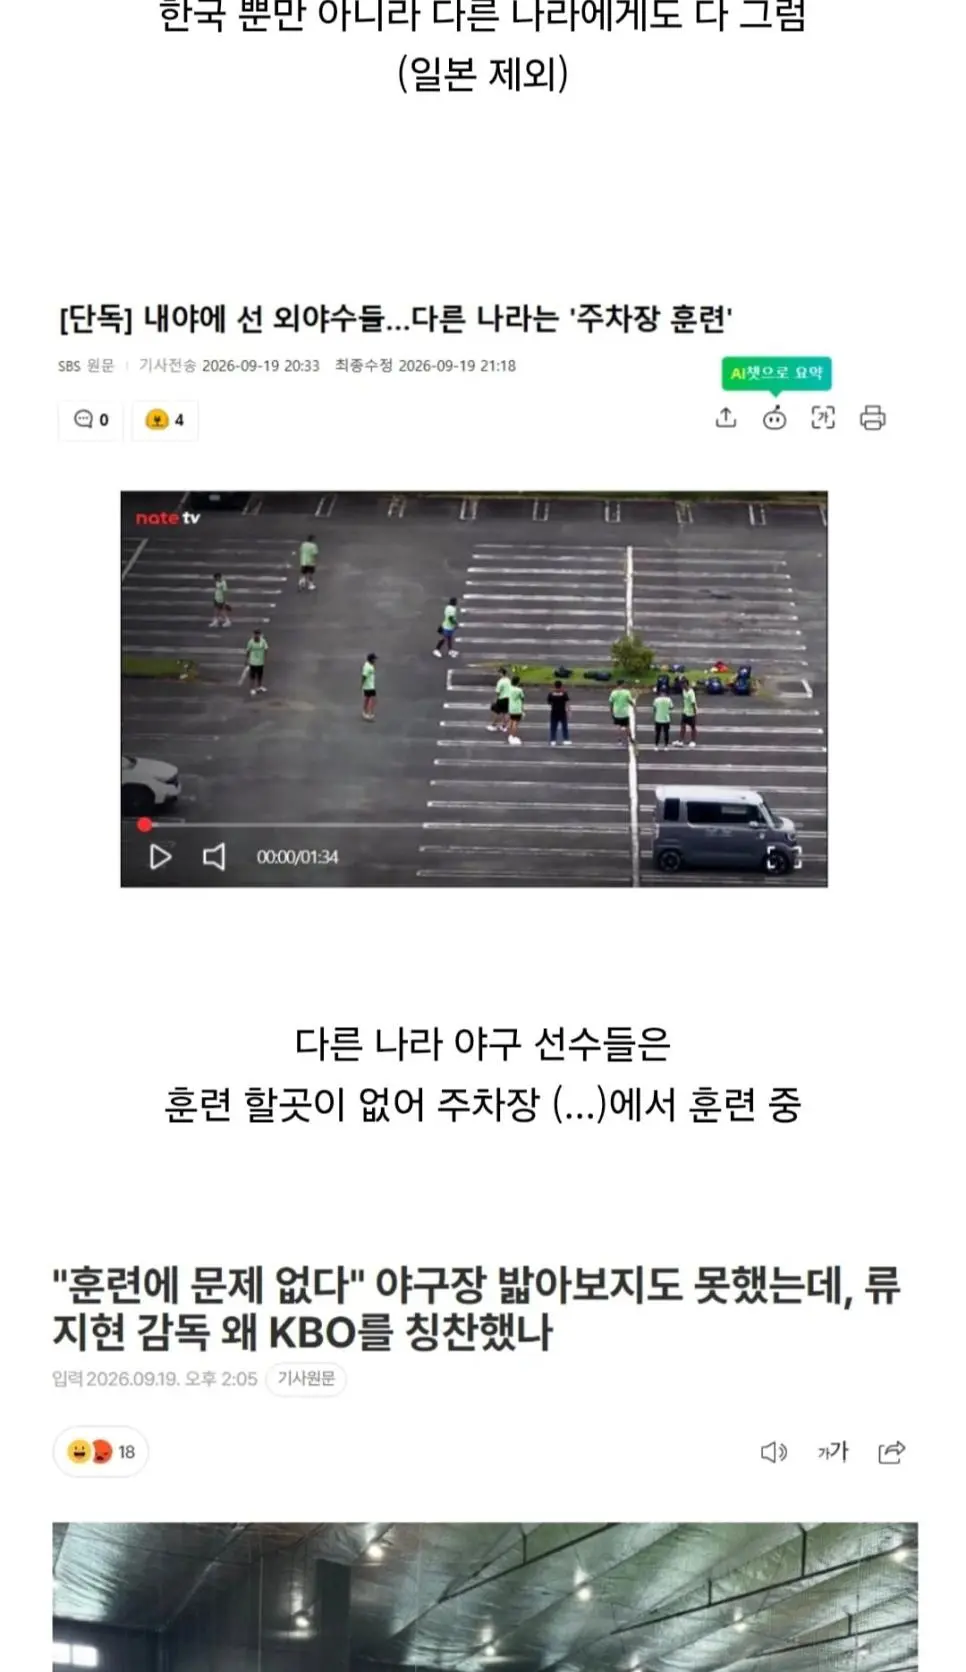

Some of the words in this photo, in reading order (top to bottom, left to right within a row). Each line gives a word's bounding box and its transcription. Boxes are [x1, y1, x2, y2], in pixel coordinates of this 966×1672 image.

[399, 54, 477, 94] (일본
[489, 54, 567, 94] 제외)
[60, 304, 132, 336] [단독]
[144, 304, 225, 334] 내야에
[237, 305, 262, 334] 선
[478, 304, 560, 333] 나라는
[58, 361, 81, 372] SBS
[88, 359, 113, 372] 원문
[140, 359, 196, 372] 기사전송
[203, 360, 279, 372] 2026-09-19
[284, 360, 320, 372] 20:33
[336, 358, 392, 373] 최종수정
[399, 360, 475, 372] 2026-09-19
[481, 360, 516, 372] 21:18
[795, 364, 823, 381] 요약
[100, 413, 109, 426] 0
[175, 413, 184, 426] 4
[297, 1026, 363, 1062] 다른
[376, 1026, 443, 1062] 나라
[455, 1026, 522, 1062] 야구
[535, 1026, 670, 1062] 선수들은
[191, 1265, 263, 1305] 문제
[376, 1265, 488, 1305] 야구장
[499, 1265, 684, 1305] 밟아보지도
[694, 1265, 852, 1310] 못했는데,
[865, 1266, 901, 1305] 류
[53, 1312, 125, 1352] 지현
[137, 1312, 211, 1352] 감독
[221, 1312, 257, 1352] 왜
[270, 1313, 394, 1352] KBO를
[406, 1312, 554, 1352] 칭찬했나
[53, 1371, 82, 1387] 입력
[87, 1372, 179, 1386] 2026.09.19.
[186, 1371, 216, 1386] 오후
[222, 1372, 257, 1386] 2:05
[279, 1370, 334, 1386] 기사원문
[119, 1445, 135, 1459] 18
